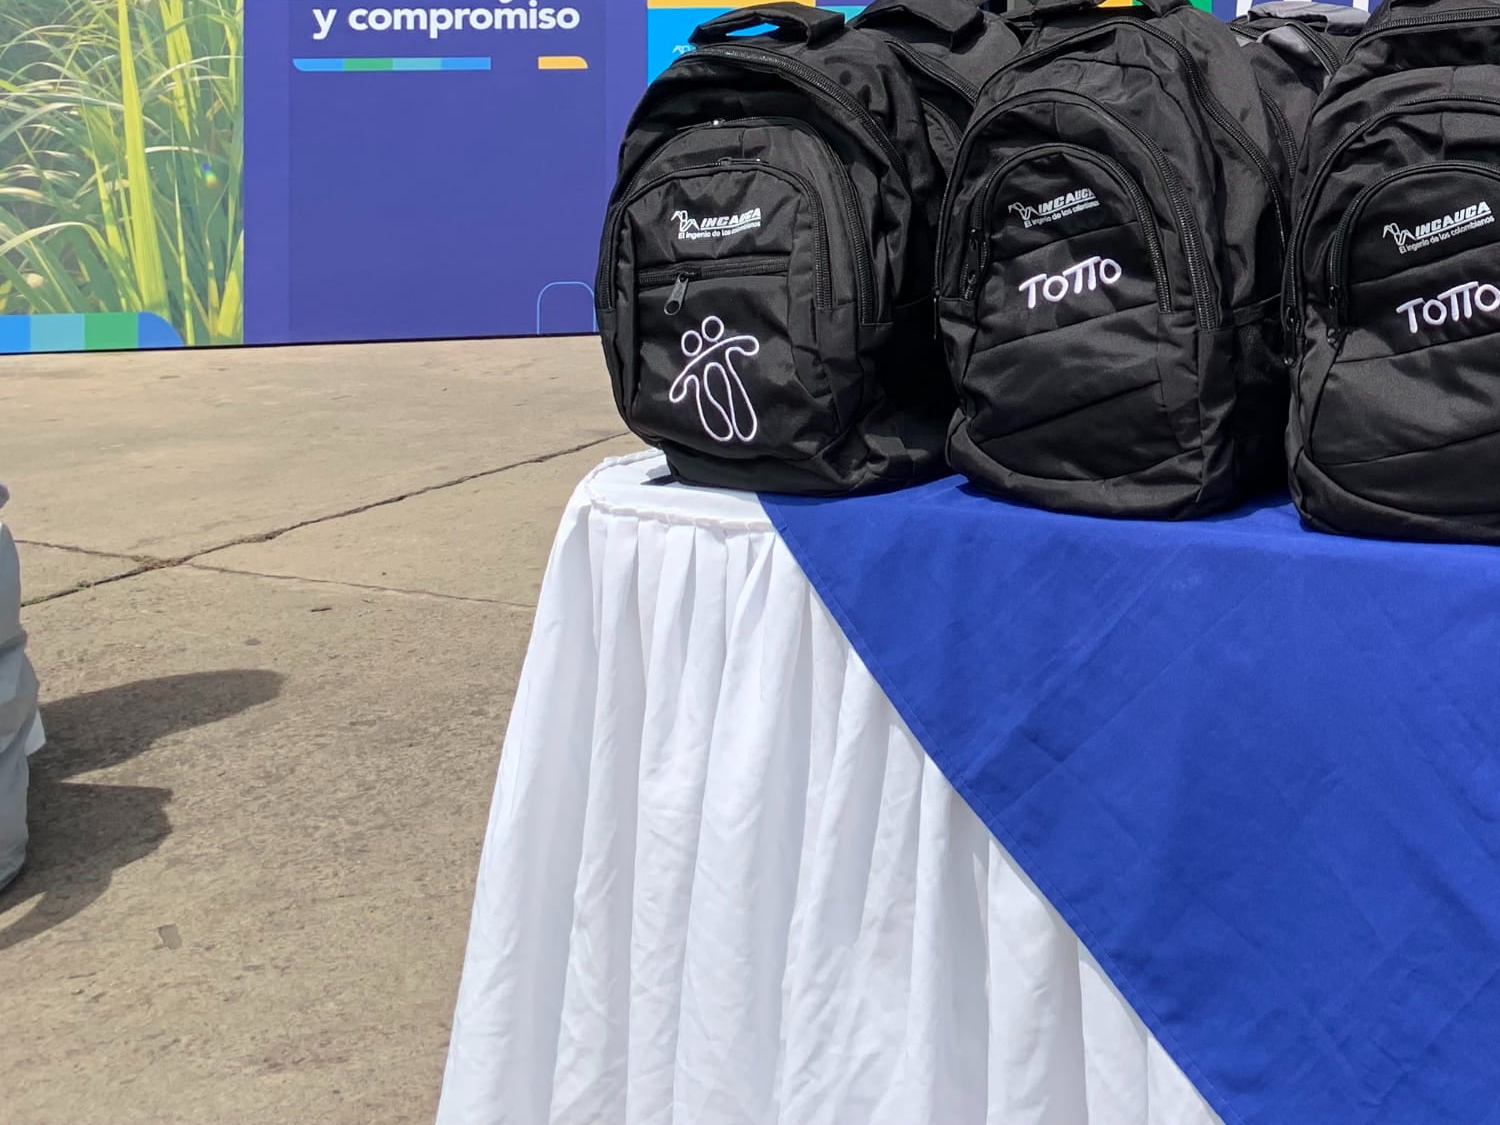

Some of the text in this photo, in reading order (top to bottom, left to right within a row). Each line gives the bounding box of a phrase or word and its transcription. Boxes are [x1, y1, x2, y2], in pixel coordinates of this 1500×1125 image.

[312, 0, 581, 40] y compromiso
[1052, 212, 1061, 221] de
[1061, 208, 1073, 219] los
[1415, 201, 1492, 236] INCAUCA
[686, 231, 711, 240] ingenio
[712, 229, 720, 237] de
[1399, 215, 1495, 254] El ingenio de los colombianos
[1019, 256, 1122, 309] TOTTO
